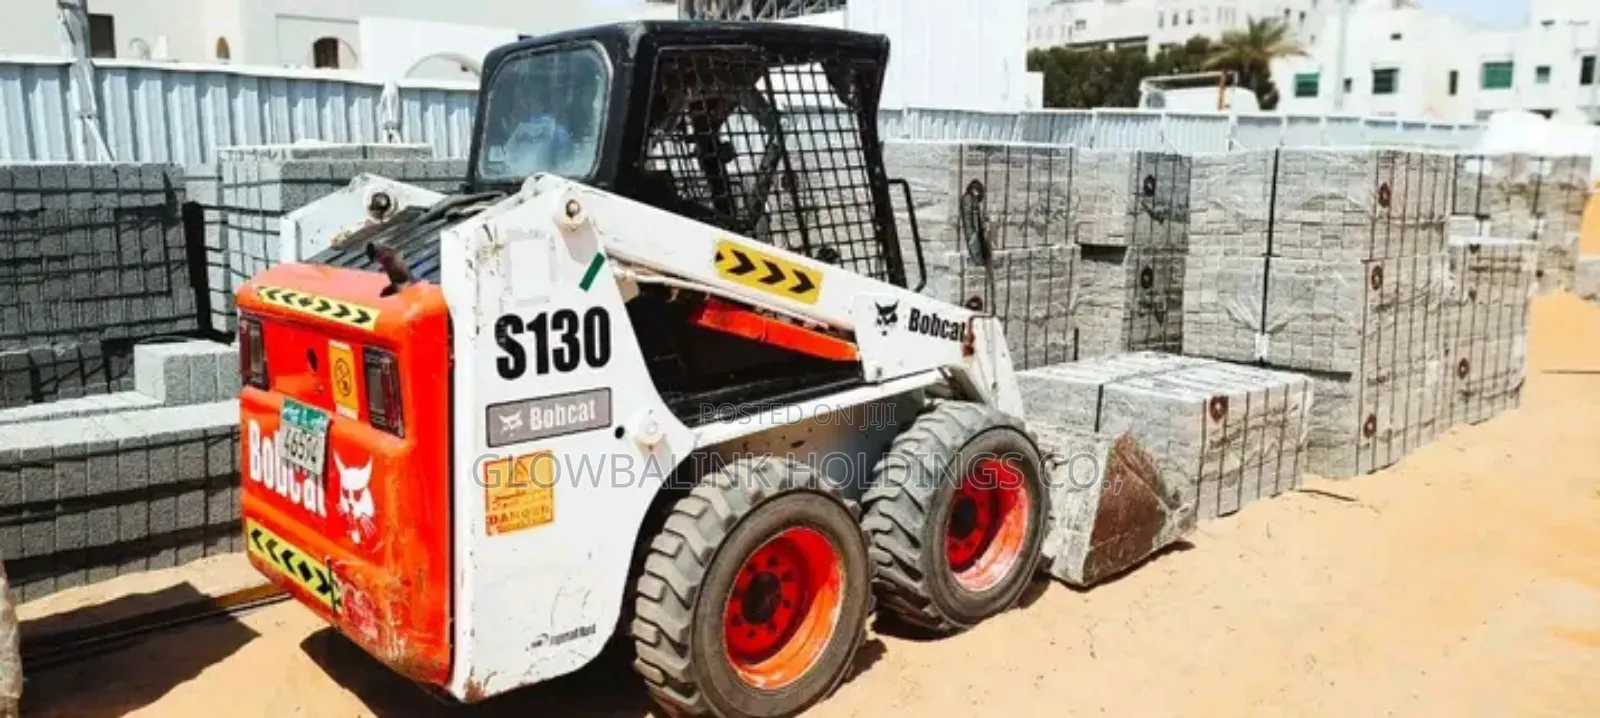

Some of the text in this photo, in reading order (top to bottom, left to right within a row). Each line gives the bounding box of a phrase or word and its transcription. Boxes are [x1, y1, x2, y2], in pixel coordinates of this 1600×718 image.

[908, 307, 966, 343] Bobcat
[494, 306, 611, 381] S130
[529, 399, 597, 432] Bobcat
